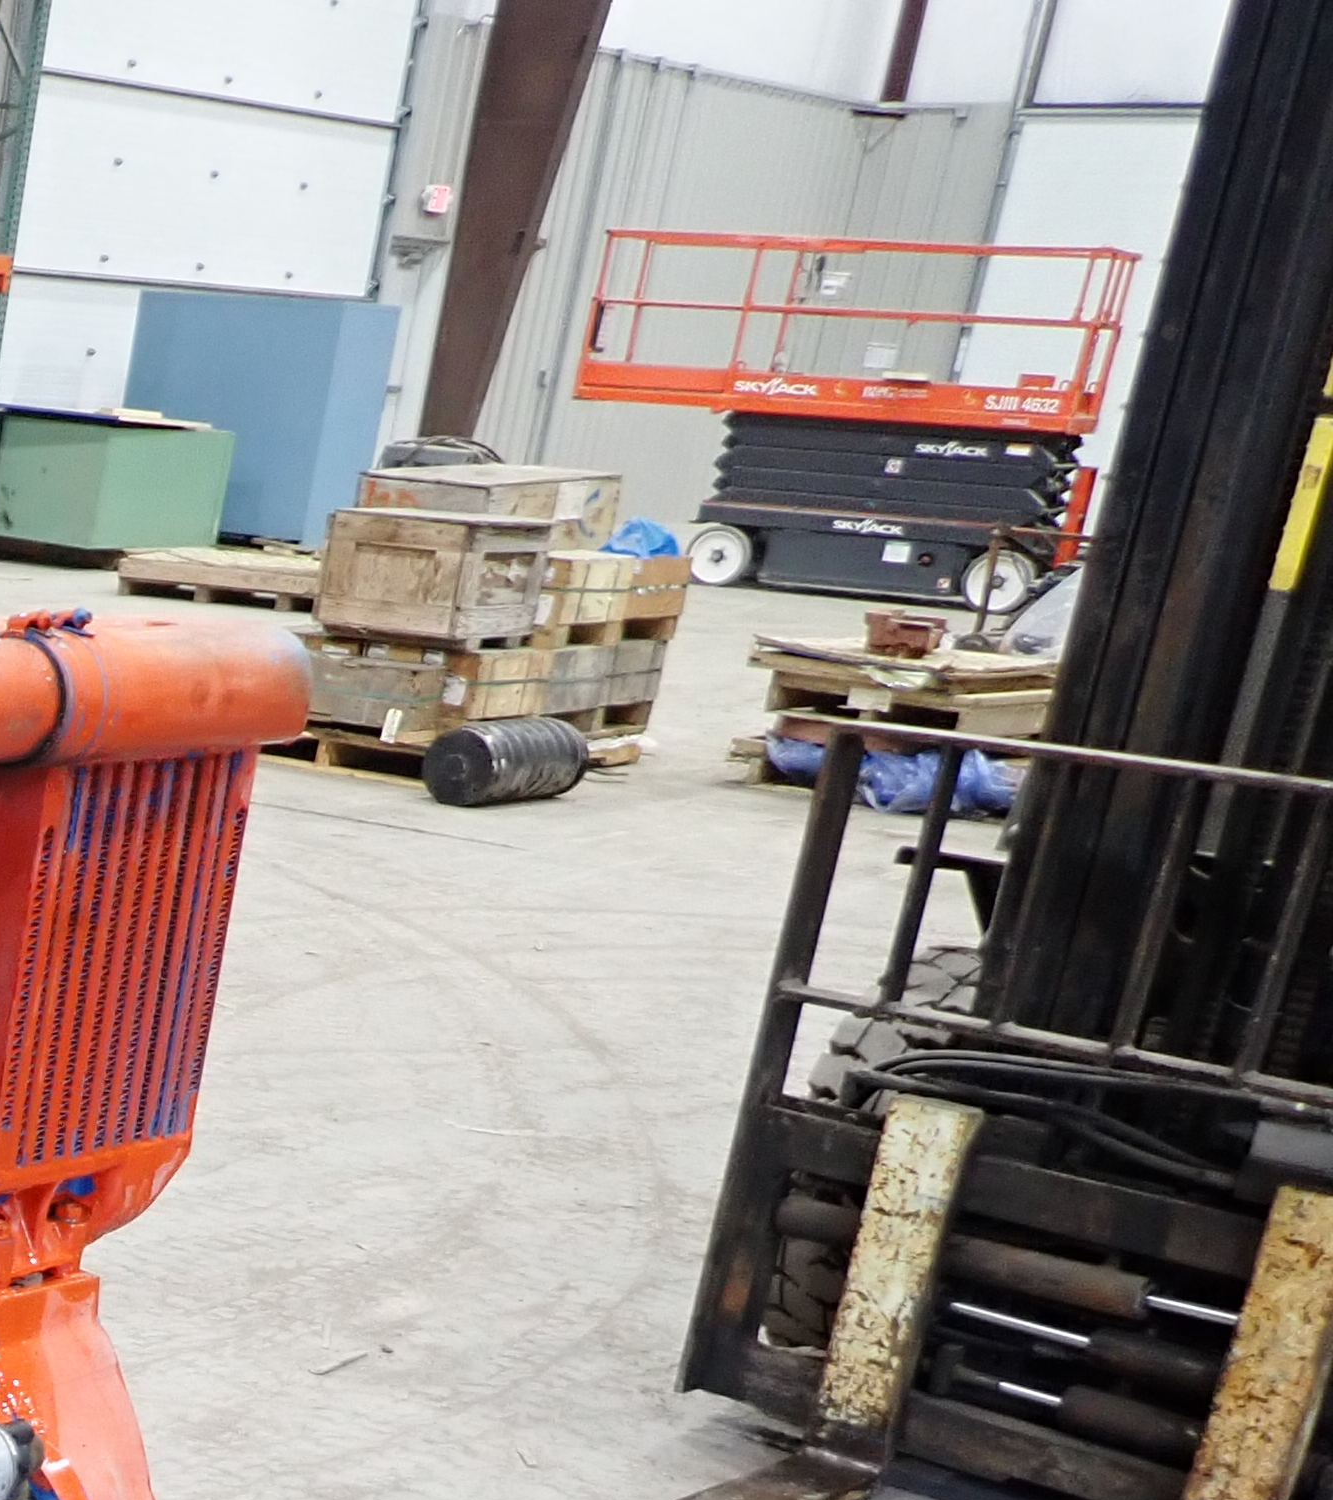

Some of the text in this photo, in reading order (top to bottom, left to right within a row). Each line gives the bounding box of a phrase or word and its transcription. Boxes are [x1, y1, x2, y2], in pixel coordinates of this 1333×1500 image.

[734, 377, 818, 396] SKYJACK
[1021, 397, 1060, 414] 4632
[914, 440, 988, 457] SKYJACK
[833, 518, 903, 535] SKYJACK
